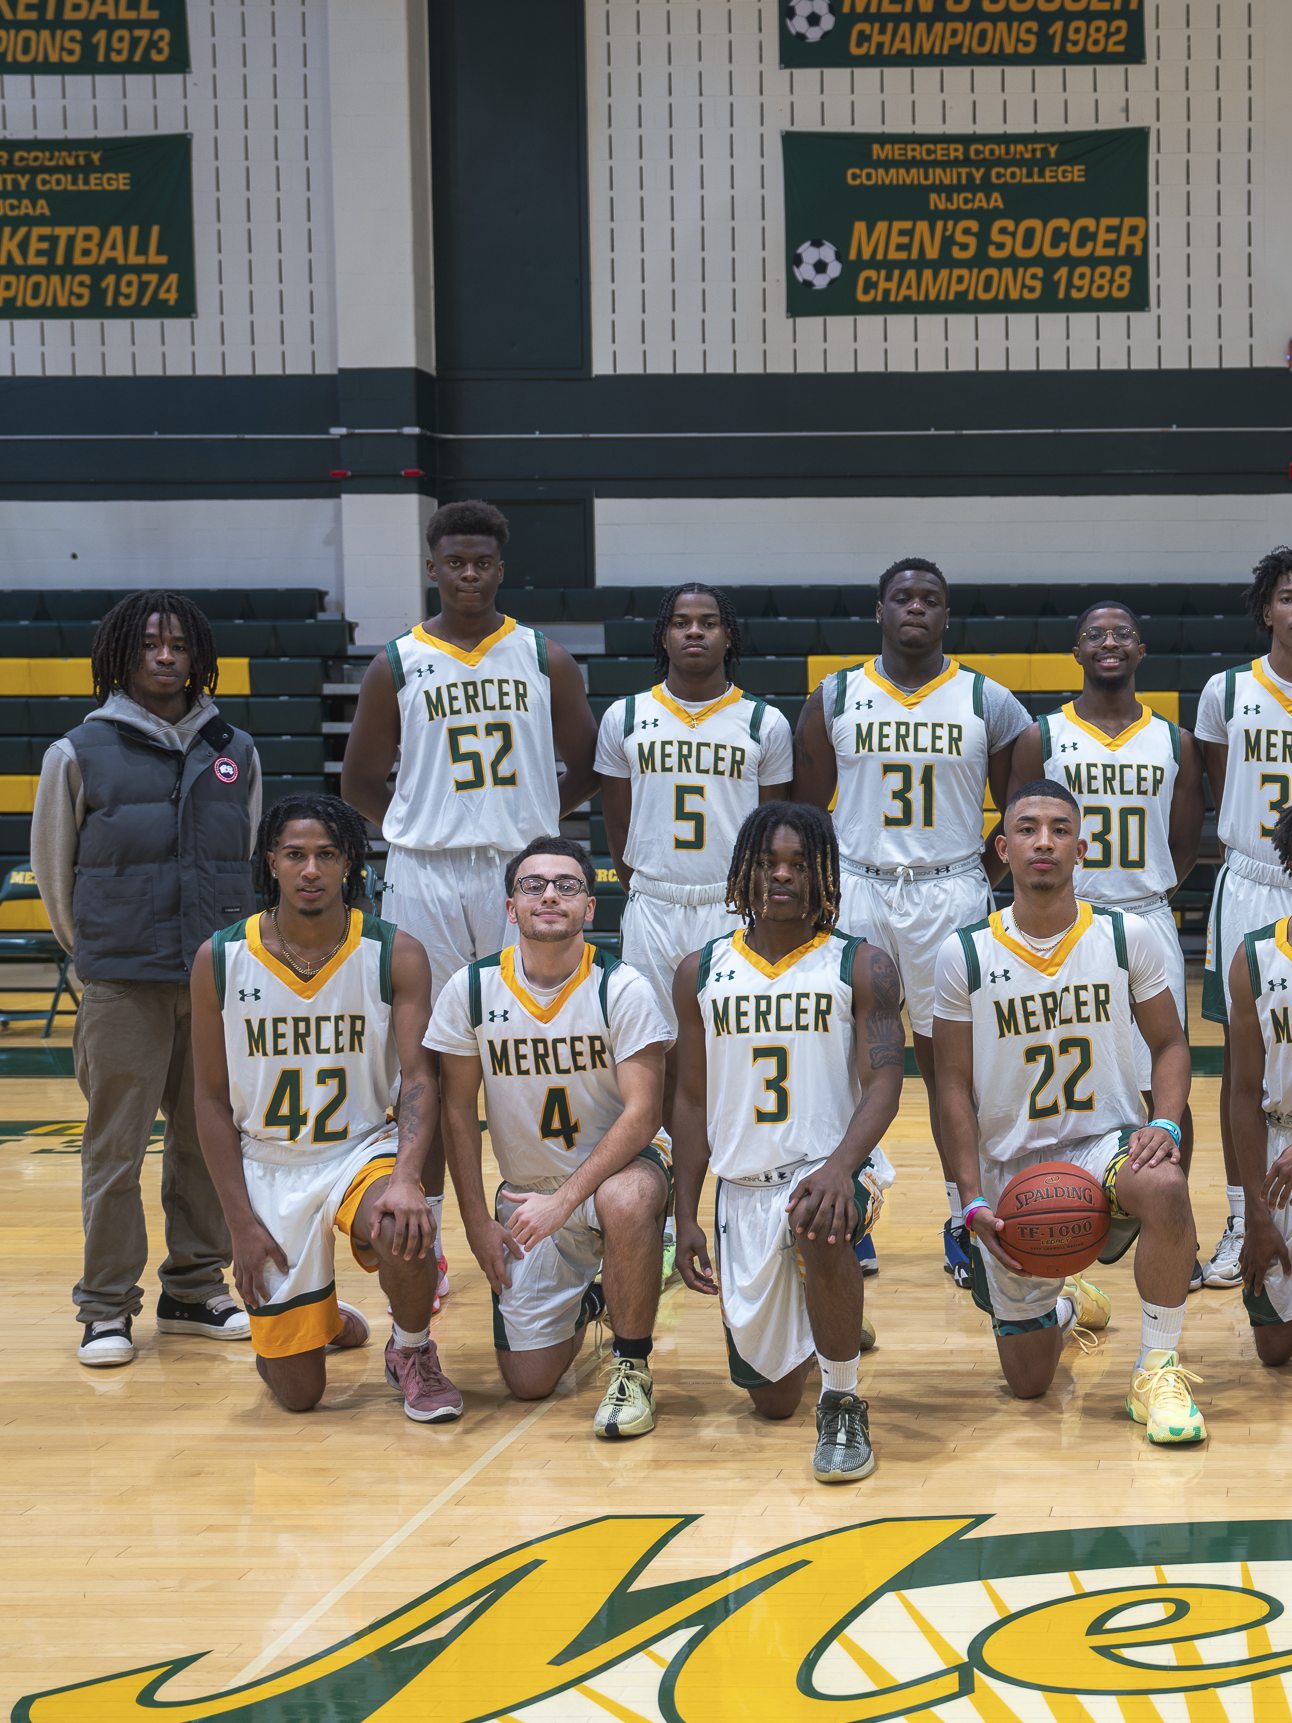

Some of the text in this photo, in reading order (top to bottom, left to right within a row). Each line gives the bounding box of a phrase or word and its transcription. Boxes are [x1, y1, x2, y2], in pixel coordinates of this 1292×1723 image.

[92, 28, 171, 62] 1973
[849, 19, 1128, 55] CHAMPIONS 1982
[13, 150, 102, 166] COUNTY
[872, 143, 1060, 161] MERCER COUNTY
[36, 173, 131, 191] COLLEGE
[846, 165, 1086, 186] COMMUNITY COLLEGE
[929, 192, 1004, 210] NJCAA
[848, 216, 1147, 260] MEN'S SOCCER
[100, 273, 179, 306] 1974
[856, 265, 1132, 302] CHAMPIONS 1988
[423, 678, 529, 723] MERCER
[446, 720, 518, 793] 52
[854, 720, 963, 757] MERCER
[637, 740, 746, 780] MERCER
[1063, 762, 1165, 797] MERCER
[881, 762, 935, 829] 31
[673, 783, 706, 852] 5
[1080, 805, 1146, 871] 30
[711, 991, 833, 1038] MERCER
[992, 982, 1111, 1040] MERCER
[243, 1013, 366, 1057] MERCER
[487, 1034, 609, 1077] MERCER
[751, 1044, 791, 1125] 3
[1023, 1035, 1095, 1122] 22
[263, 1066, 350, 1144] 42
[539, 1086, 582, 1152] 4
[1015, 1186, 1093, 1211] SPALDING
[1017, 1220, 1092, 1239] TF-1000
[1041, 1237, 1072, 1246] LEGACY
